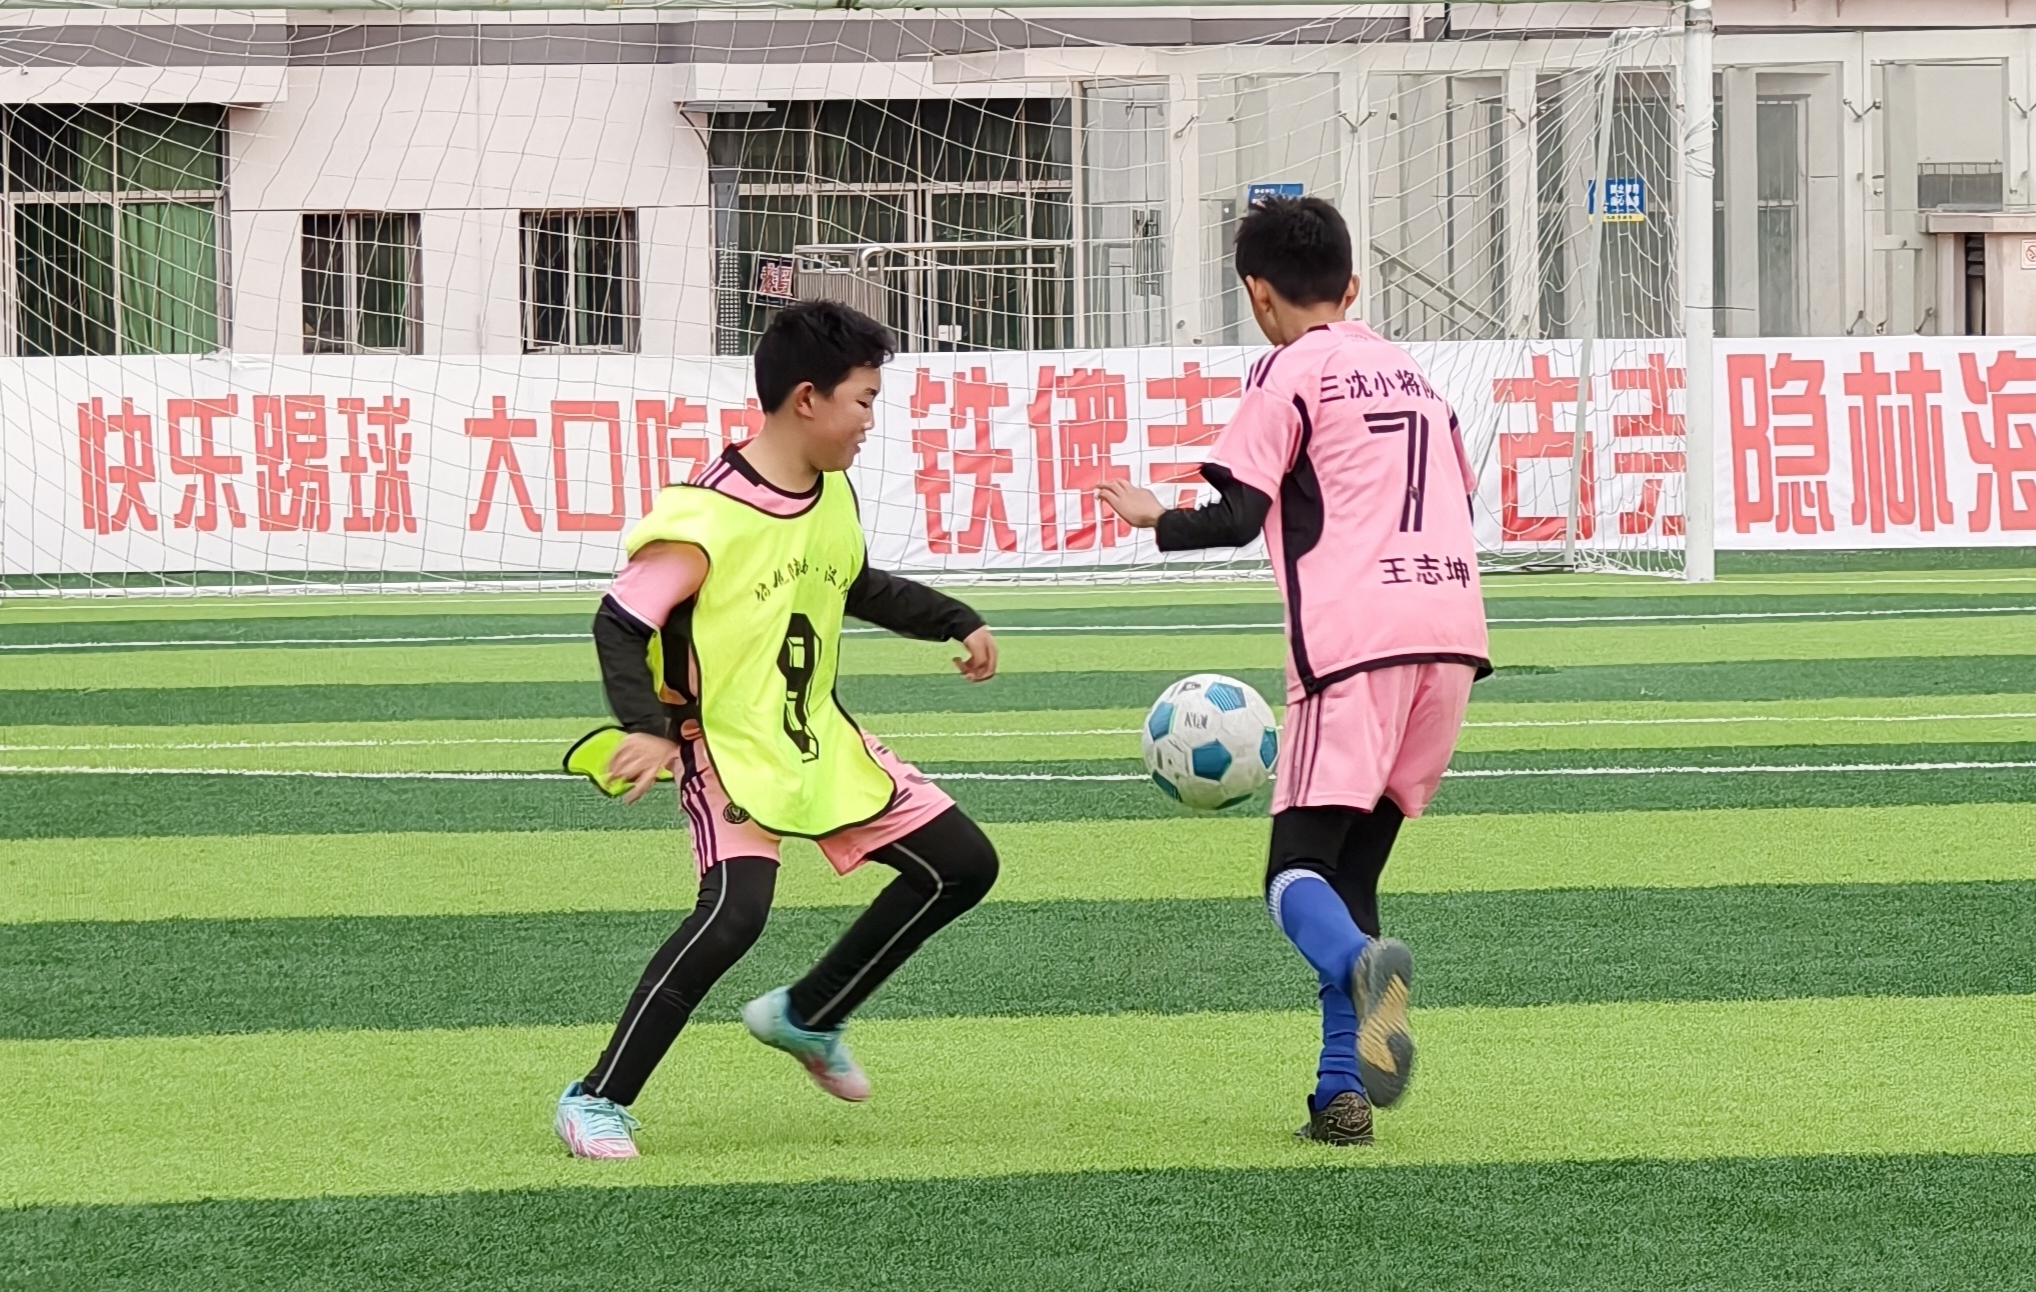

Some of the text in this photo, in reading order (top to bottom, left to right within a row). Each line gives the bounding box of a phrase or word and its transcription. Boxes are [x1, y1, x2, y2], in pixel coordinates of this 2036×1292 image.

[77, 394, 417, 535] 快乐踢球
[1363, 410, 1430, 533] 7
[1378, 554, 1471, 588] 王志坤
